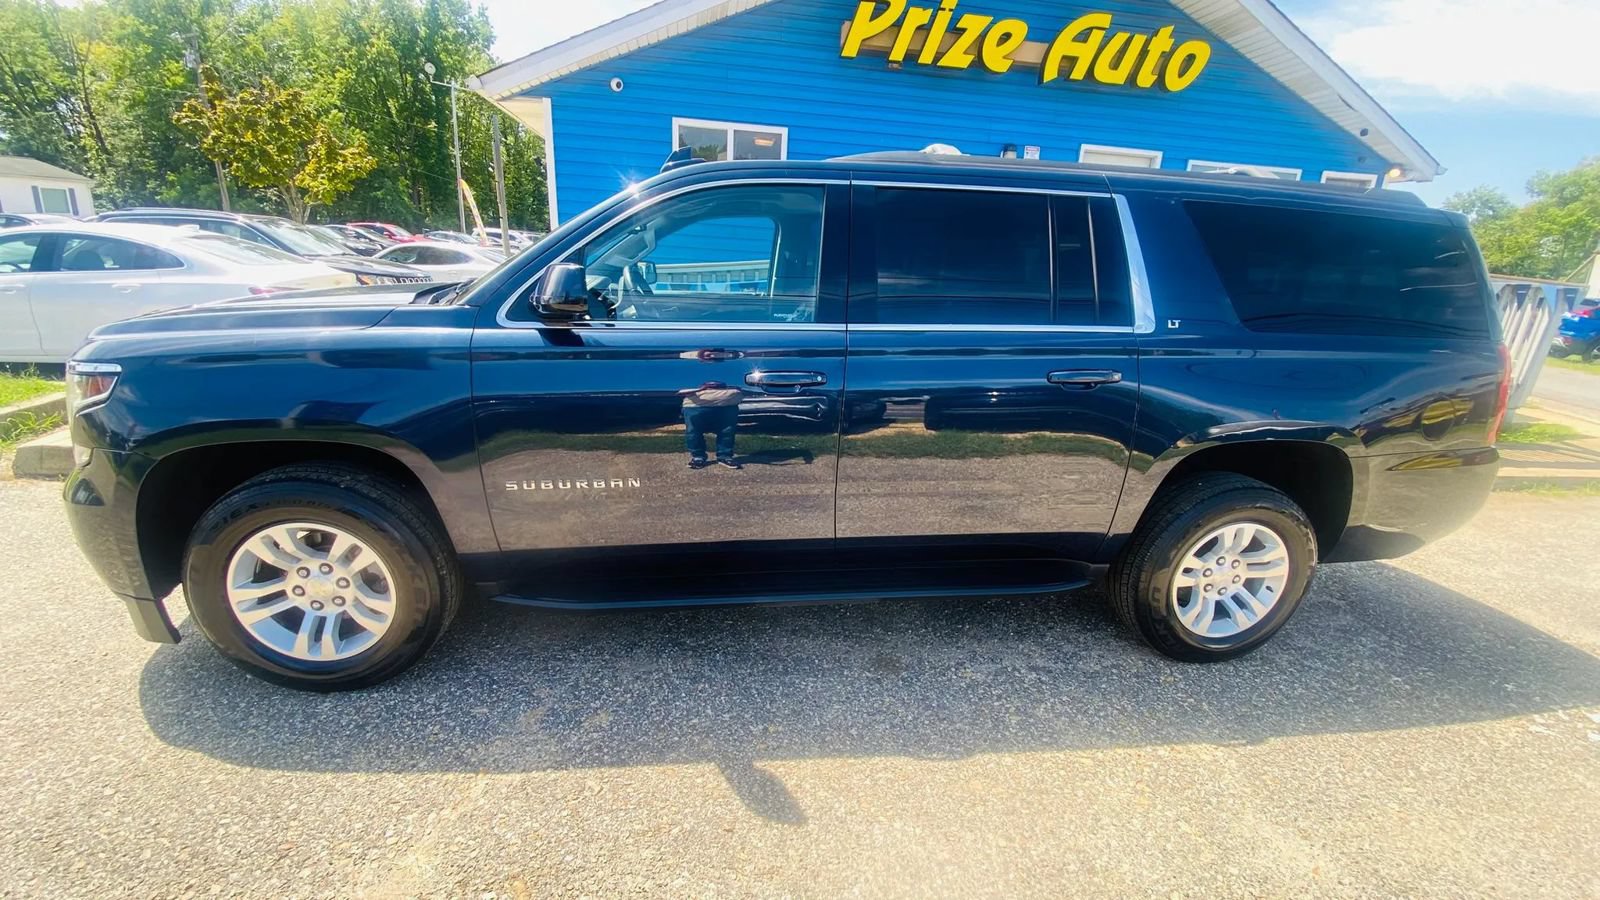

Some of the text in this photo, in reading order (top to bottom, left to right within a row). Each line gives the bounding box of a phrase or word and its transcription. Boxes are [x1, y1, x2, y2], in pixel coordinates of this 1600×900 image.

[840, 0, 1212, 93] Prize Auto
[1167, 319, 1182, 329] LT
[505, 477, 641, 491] SUBURBAN
